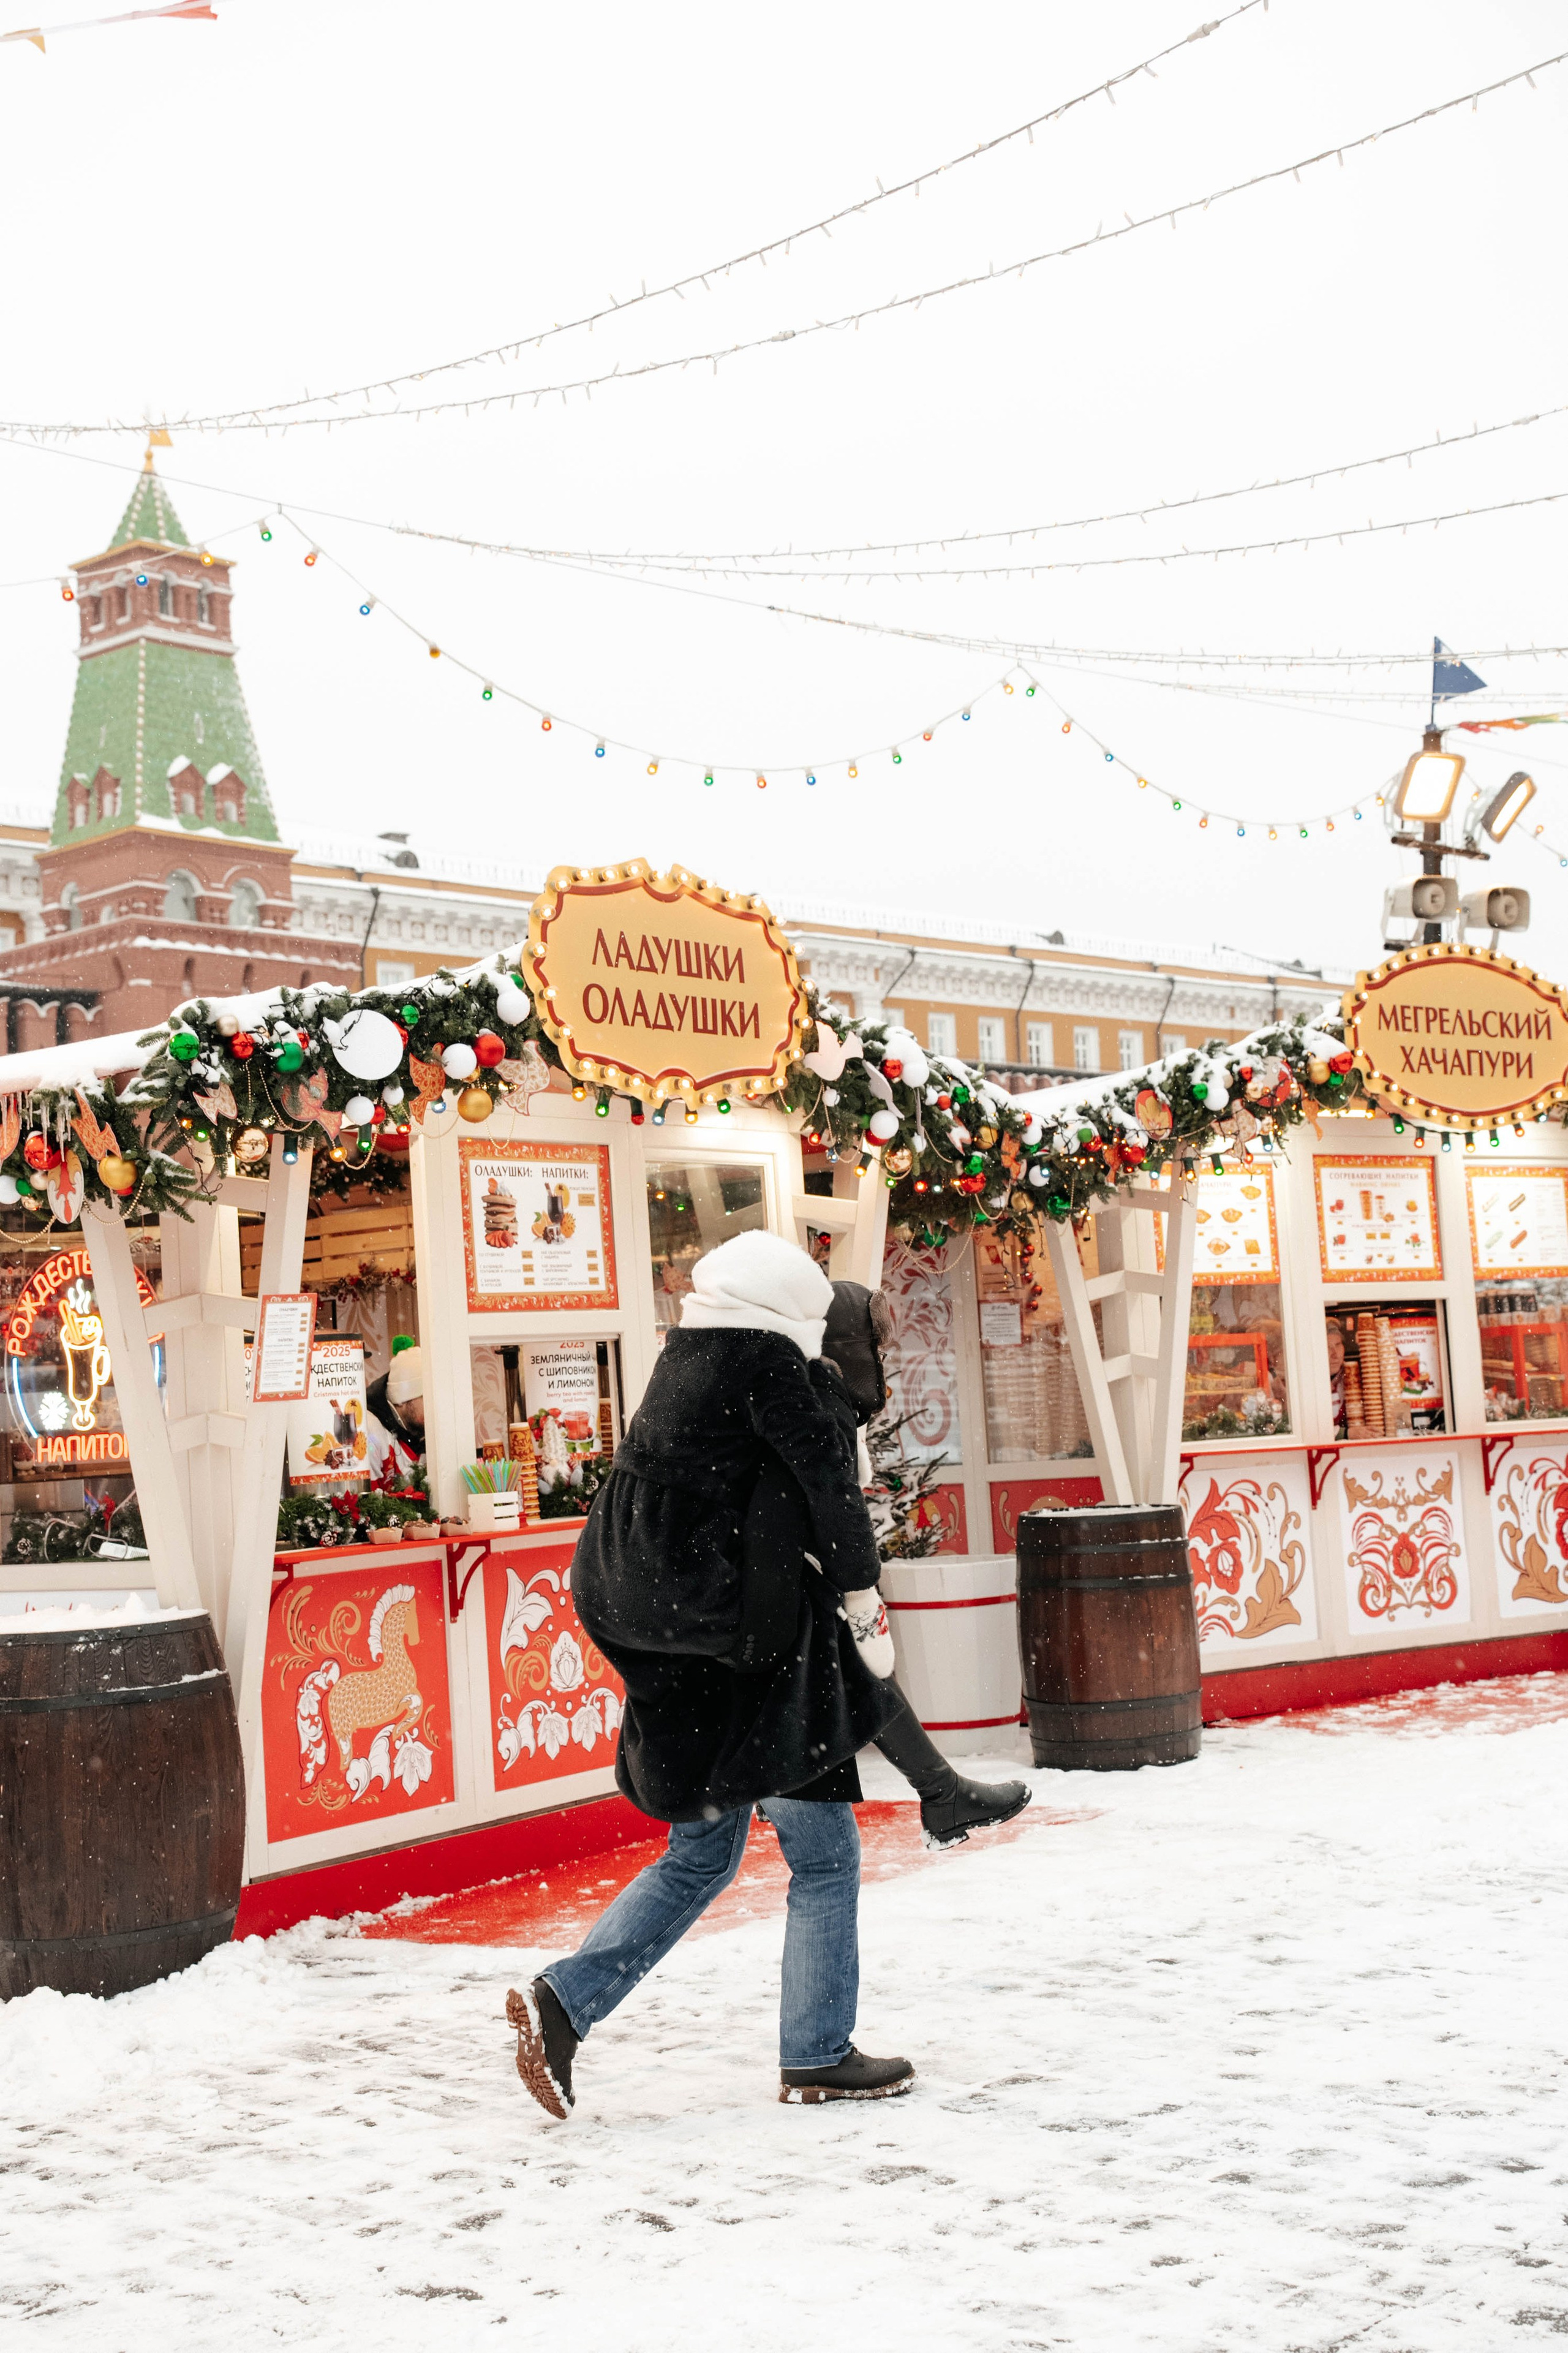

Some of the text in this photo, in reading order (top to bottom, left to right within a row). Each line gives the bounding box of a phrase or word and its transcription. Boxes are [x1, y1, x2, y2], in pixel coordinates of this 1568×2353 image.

[592, 927, 745, 984] ЛАДУШКИ
[582, 983, 760, 1039] ОЛАДУШКИ
[1378, 1003, 1552, 1040] МЕГРЕЛЬСКИЙ
[1400, 1045, 1533, 1079] ХАЧАПУРИ
[475, 1165, 589, 1179] ОЛАДУШКИ: НАПИТКИ:
[323, 1346, 350, 1358] 2025
[530, 1351, 590, 1365] ЗЕМЛЯНИЧНЫЙ
[538, 1368, 545, 1377] С
[317, 1376, 357, 1388] НАПИТОК
[548, 1380, 554, 1389] И
[37, 1432, 130, 1464] НАПИТО
